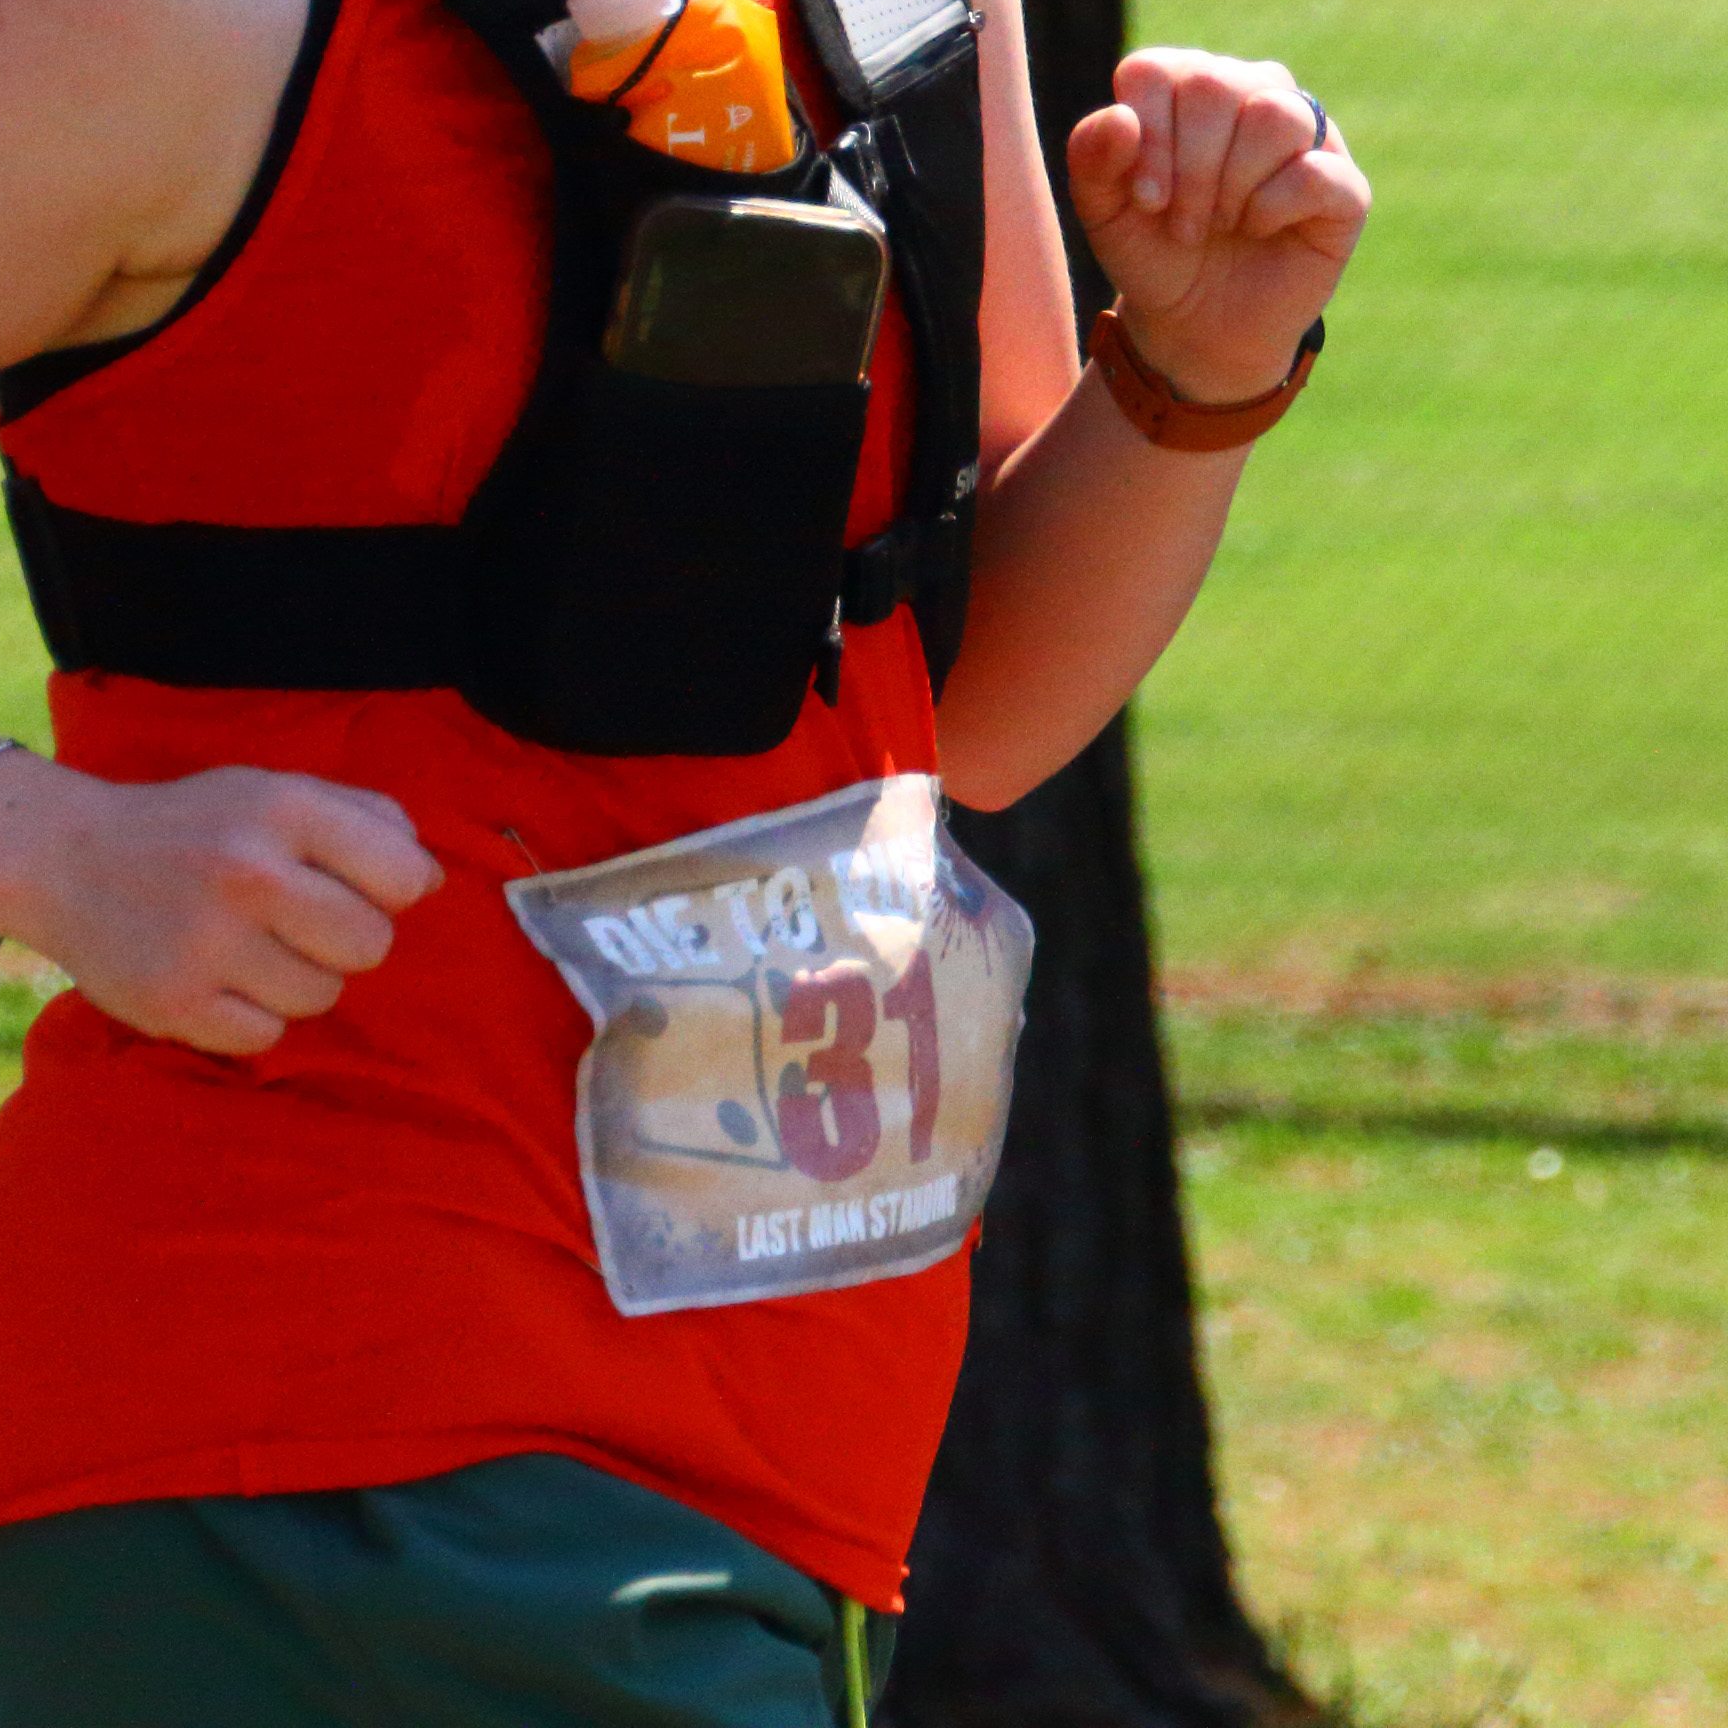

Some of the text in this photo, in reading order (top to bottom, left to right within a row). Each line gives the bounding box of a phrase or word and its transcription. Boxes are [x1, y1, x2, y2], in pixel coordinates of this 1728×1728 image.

[583, 893, 722, 976] DIE
[713, 866, 819, 955] TO
[777, 949, 941, 1182] 31
[737, 1208, 803, 1261] LAST
[809, 1198, 867, 1249] MAN
